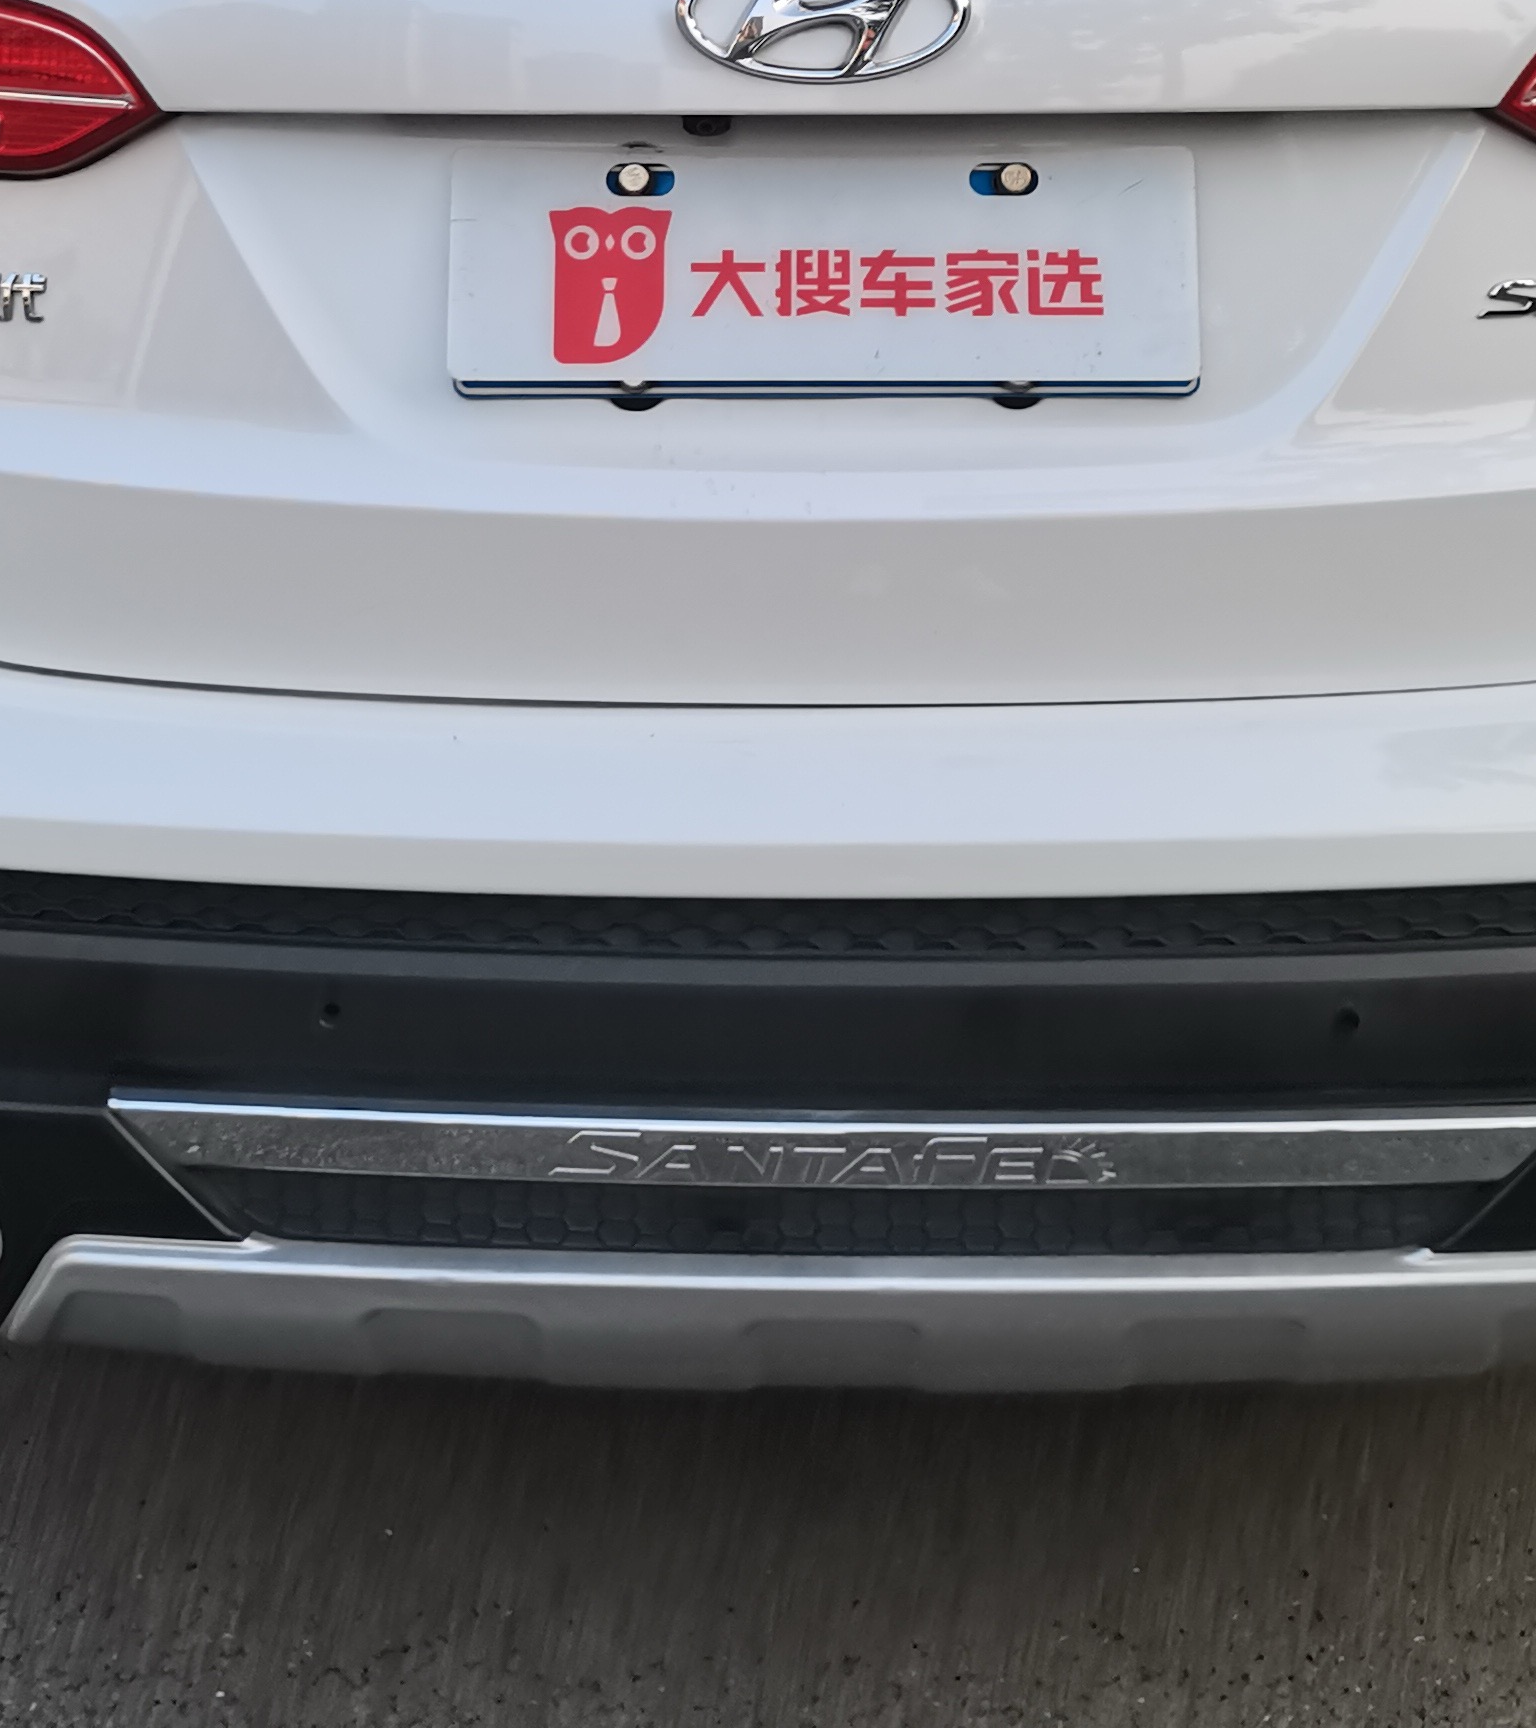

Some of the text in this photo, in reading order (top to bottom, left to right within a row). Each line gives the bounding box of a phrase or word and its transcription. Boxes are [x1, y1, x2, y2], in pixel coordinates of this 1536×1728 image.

[690, 248, 1105, 318] 大搜车家选
